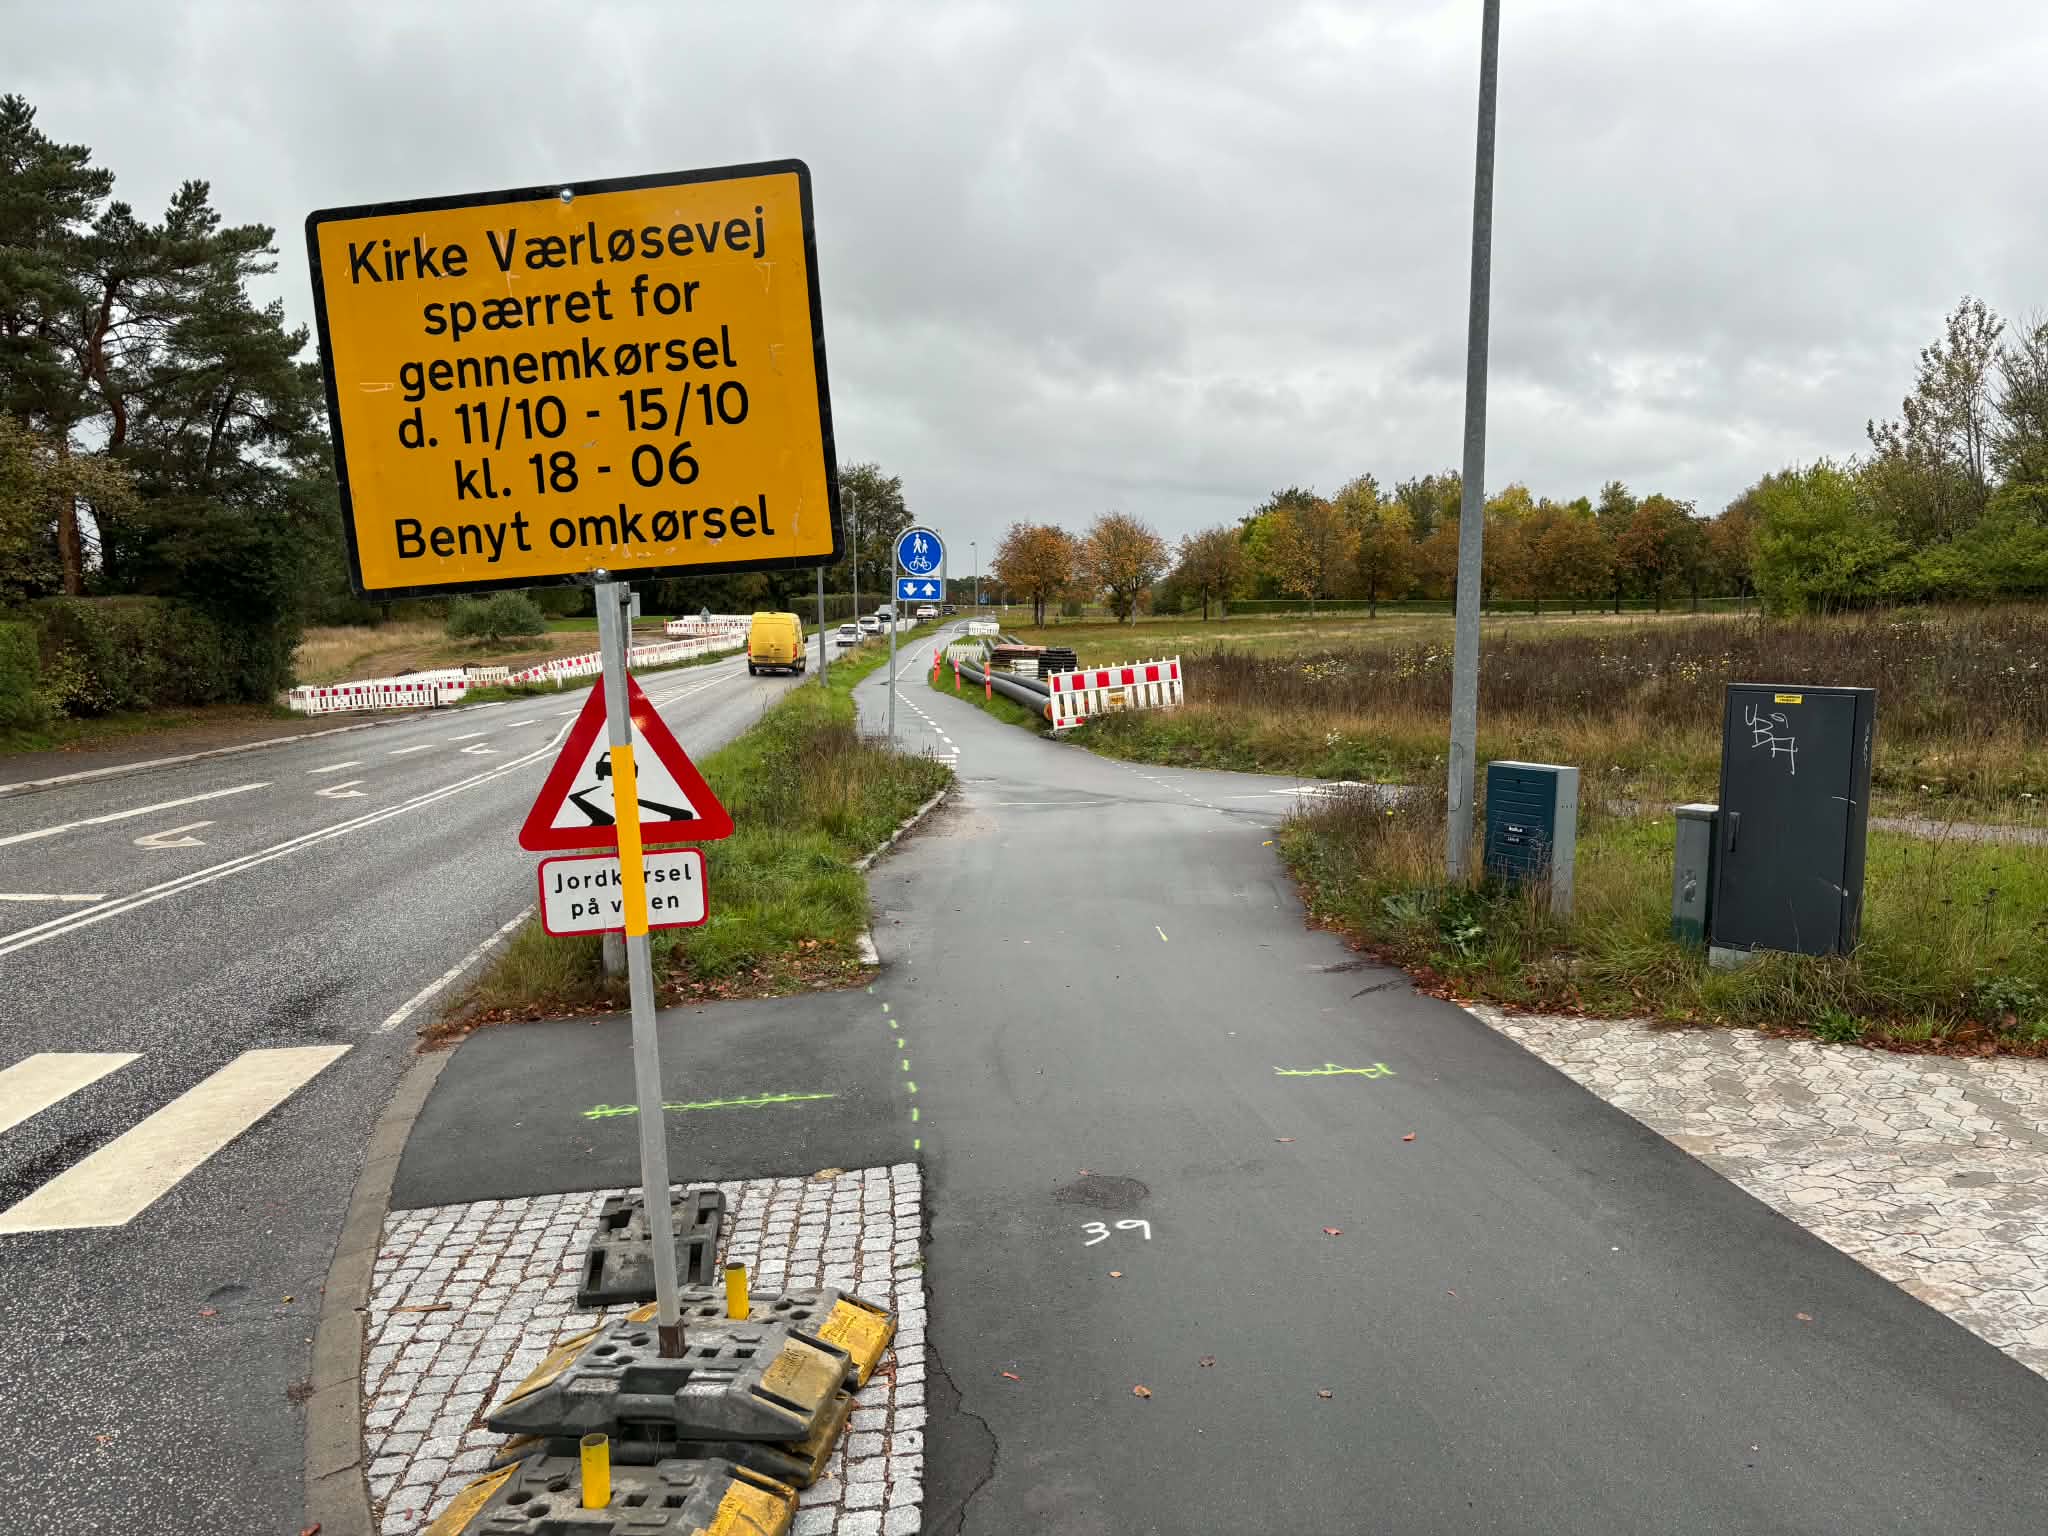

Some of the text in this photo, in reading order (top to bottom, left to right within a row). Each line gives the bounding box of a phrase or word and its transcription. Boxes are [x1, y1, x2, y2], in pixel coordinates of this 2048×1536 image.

[349, 205, 767, 285] Kirke Værløsevej
[422, 273, 700, 343] spærret for
[398, 324, 738, 402] gennemkørsel
[398, 380, 749, 451] d. 11/10 - 15/10
[454, 440, 700, 501] kl. 18 - 06
[394, 493, 776, 563] Benyt omkørsel
[554, 863, 693, 893] Jordkrsel
[571, 895, 680, 920] på ven
[1081, 1219, 1152, 1247] 39
